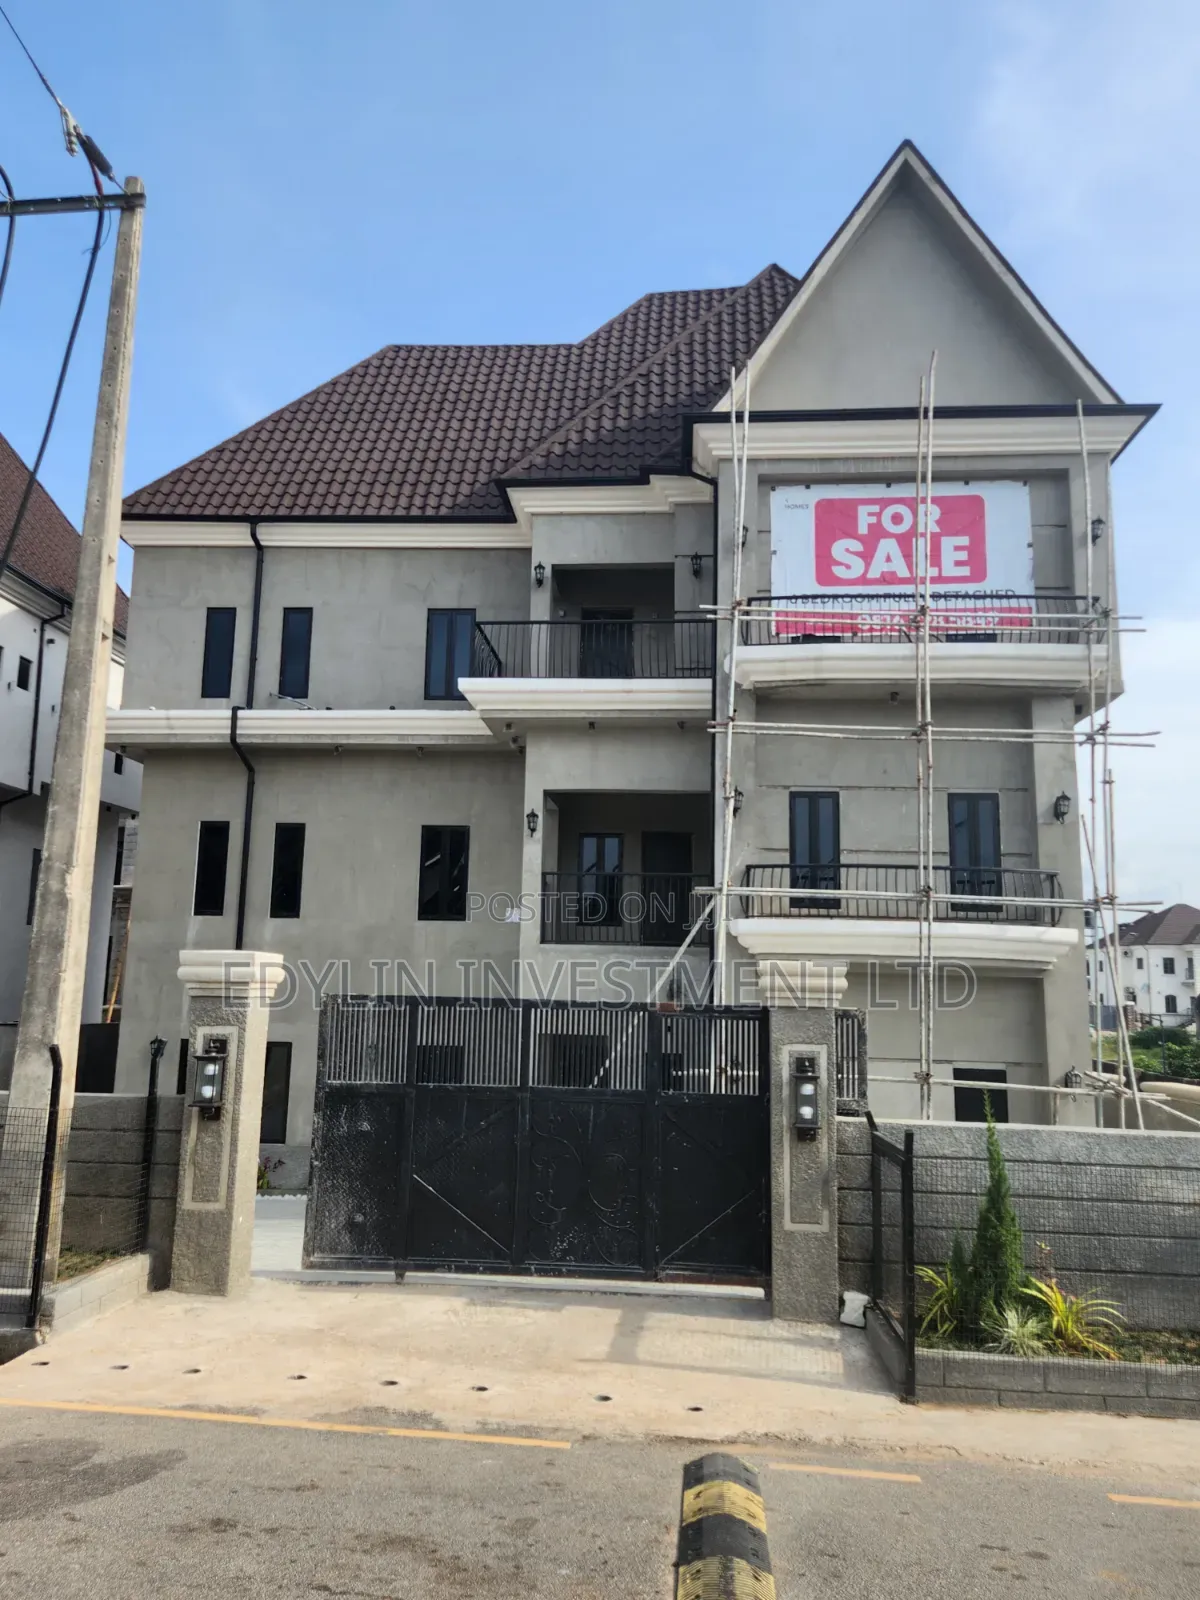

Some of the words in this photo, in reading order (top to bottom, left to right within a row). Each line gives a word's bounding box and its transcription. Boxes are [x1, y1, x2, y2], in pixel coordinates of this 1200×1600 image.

[857, 503, 942, 535] FOR
[830, 535, 971, 580] SALE
[932, 589, 1016, 602] DETACHED
